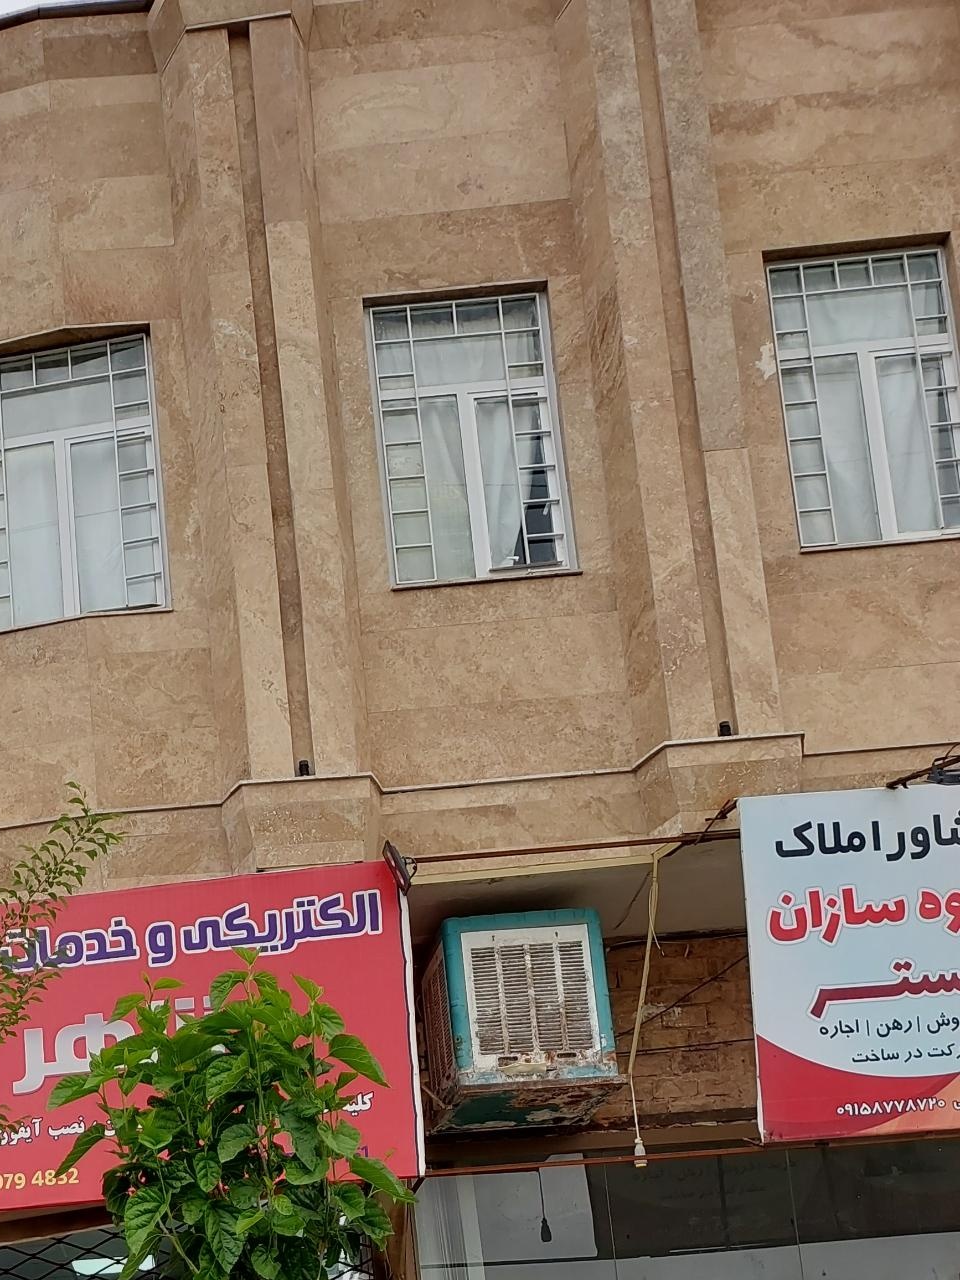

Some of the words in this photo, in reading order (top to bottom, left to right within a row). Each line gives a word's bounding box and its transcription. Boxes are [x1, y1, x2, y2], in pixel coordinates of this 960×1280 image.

[775, 820, 882, 858] املاک
[180, 889, 383, 957] الکتریکی
[767, 884, 908, 947] سازان
[145, 920, 176, 967] و
[819, 1018, 860, 1039] اجاره
[876, 1018, 913, 1038] رهن
[851, 1048, 900, 1063] ساخت
[904, 1048, 923, 1063] در
[47, 1115, 86, 1139] نصب
